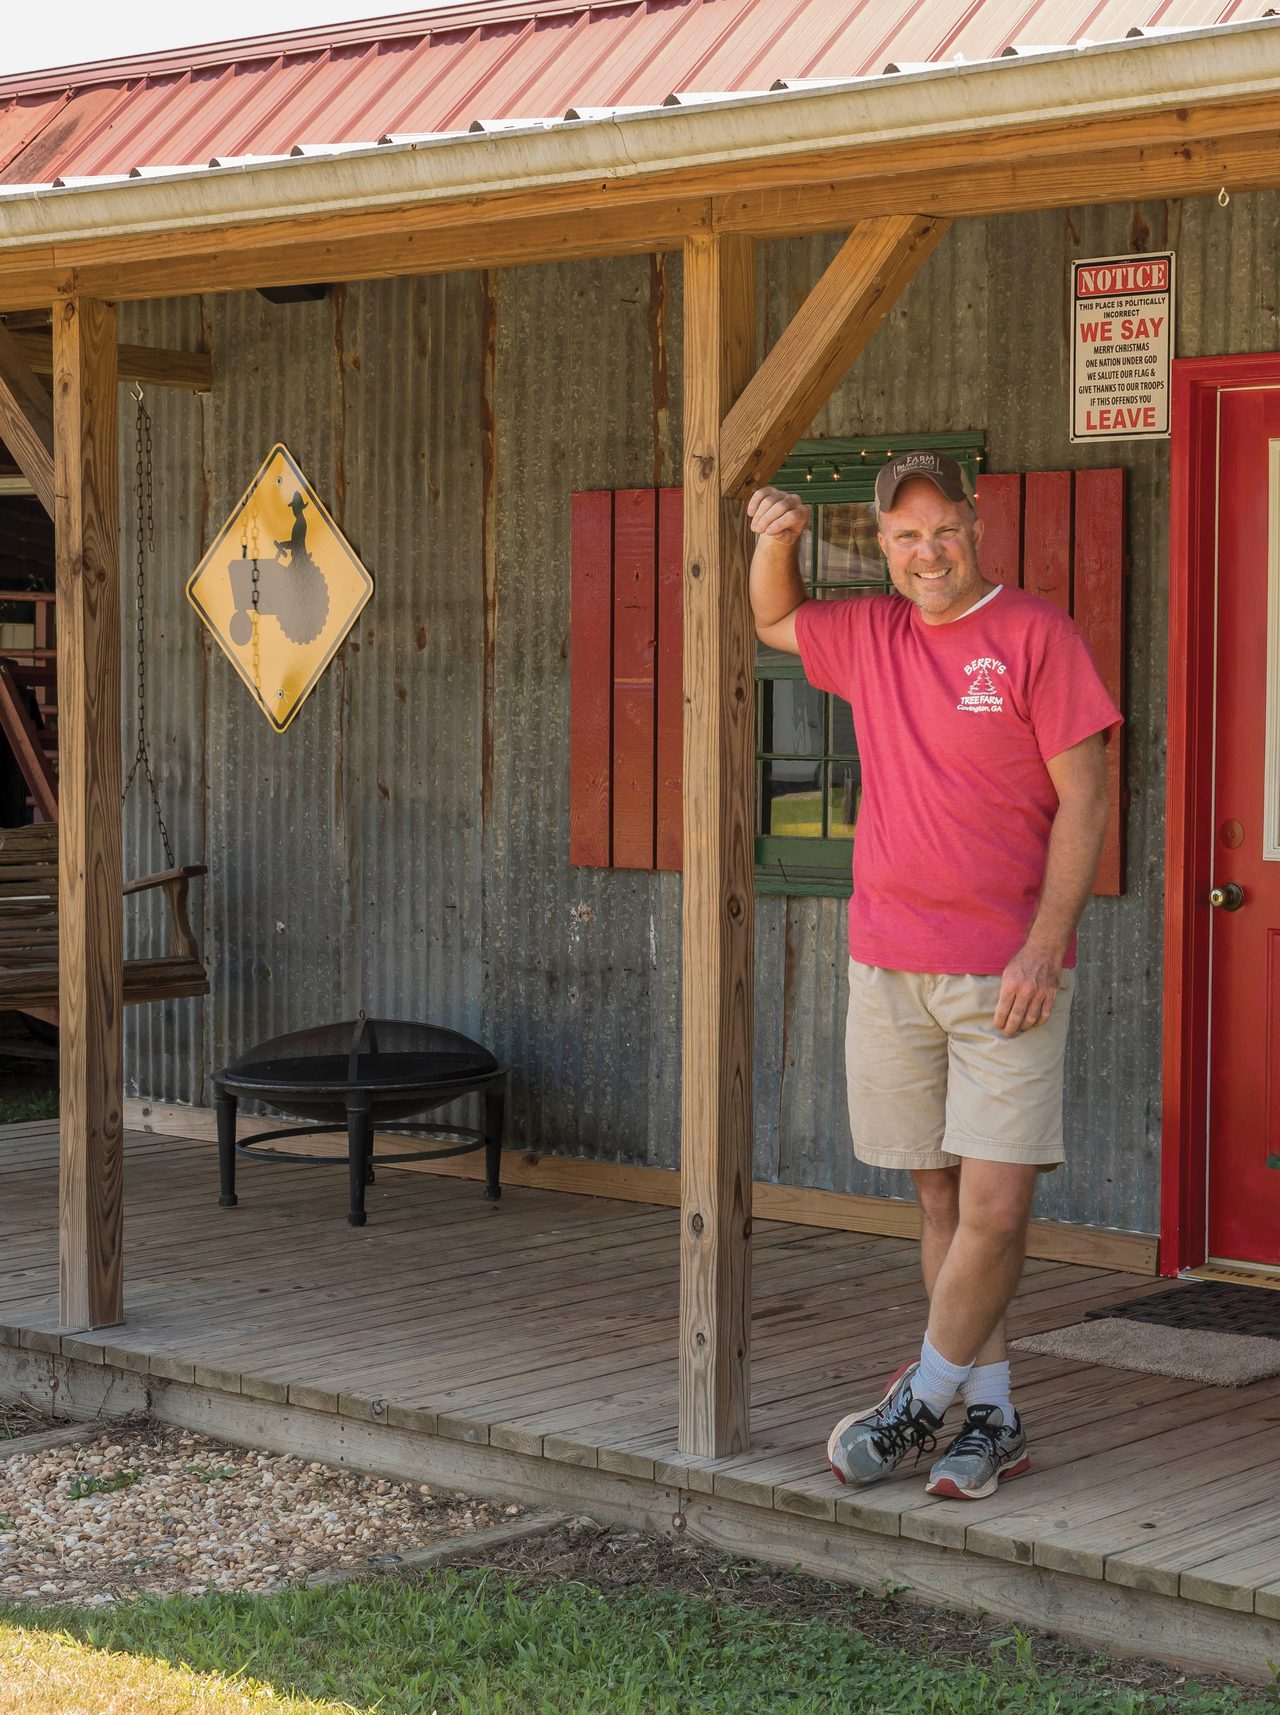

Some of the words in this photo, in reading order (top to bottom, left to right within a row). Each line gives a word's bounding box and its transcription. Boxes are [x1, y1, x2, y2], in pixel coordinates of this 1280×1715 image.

[1081, 264, 1165, 293] NOTICE
[1079, 303, 1094, 311] THIS
[1095, 301, 1115, 310] PLACE
[1125, 297, 1166, 307] POLITICALLY
[1104, 309, 1140, 319] INCORRECT
[1080, 321, 1112, 343] WE
[1121, 317, 1164, 341] SAY
[1094, 345, 1114, 354] MERRY
[1115, 342, 1149, 353] CHRISTMAS
[1085, 359, 1098, 368] ONE
[1099, 357, 1120, 367] NATION
[1122, 356, 1143, 366] UNDER
[1144, 355, 1157, 364] GOD
[1087, 372, 1096, 380] WE
[1098, 371, 1119, 380] SALUTE
[1120, 370, 1133, 378] OUR
[1134, 369, 1149, 378] FLAG
[1150, 368, 1155, 376] &
[1079, 385, 1092, 394] GIVE
[1093, 384, 1116, 393] THANKS
[1117, 383, 1125, 392] TO
[1126, 382, 1139, 391] OUR
[1140, 381, 1164, 391] TROOPS
[1090, 398, 1096, 406] IF
[1097, 397, 1110, 406] THIS
[1111, 395, 1138, 405] OFFENDS
[1139, 395, 1152, 403] YOU
[1086, 407, 1156, 430] LEAVE
[907, 456, 935, 464] FARM
[964, 658, 1006, 675] BERRY'S
[960, 696, 980, 705] TREE
[980, 696, 1003, 705] FARM
[1207, 1268, 1257, 1279] WATCH
